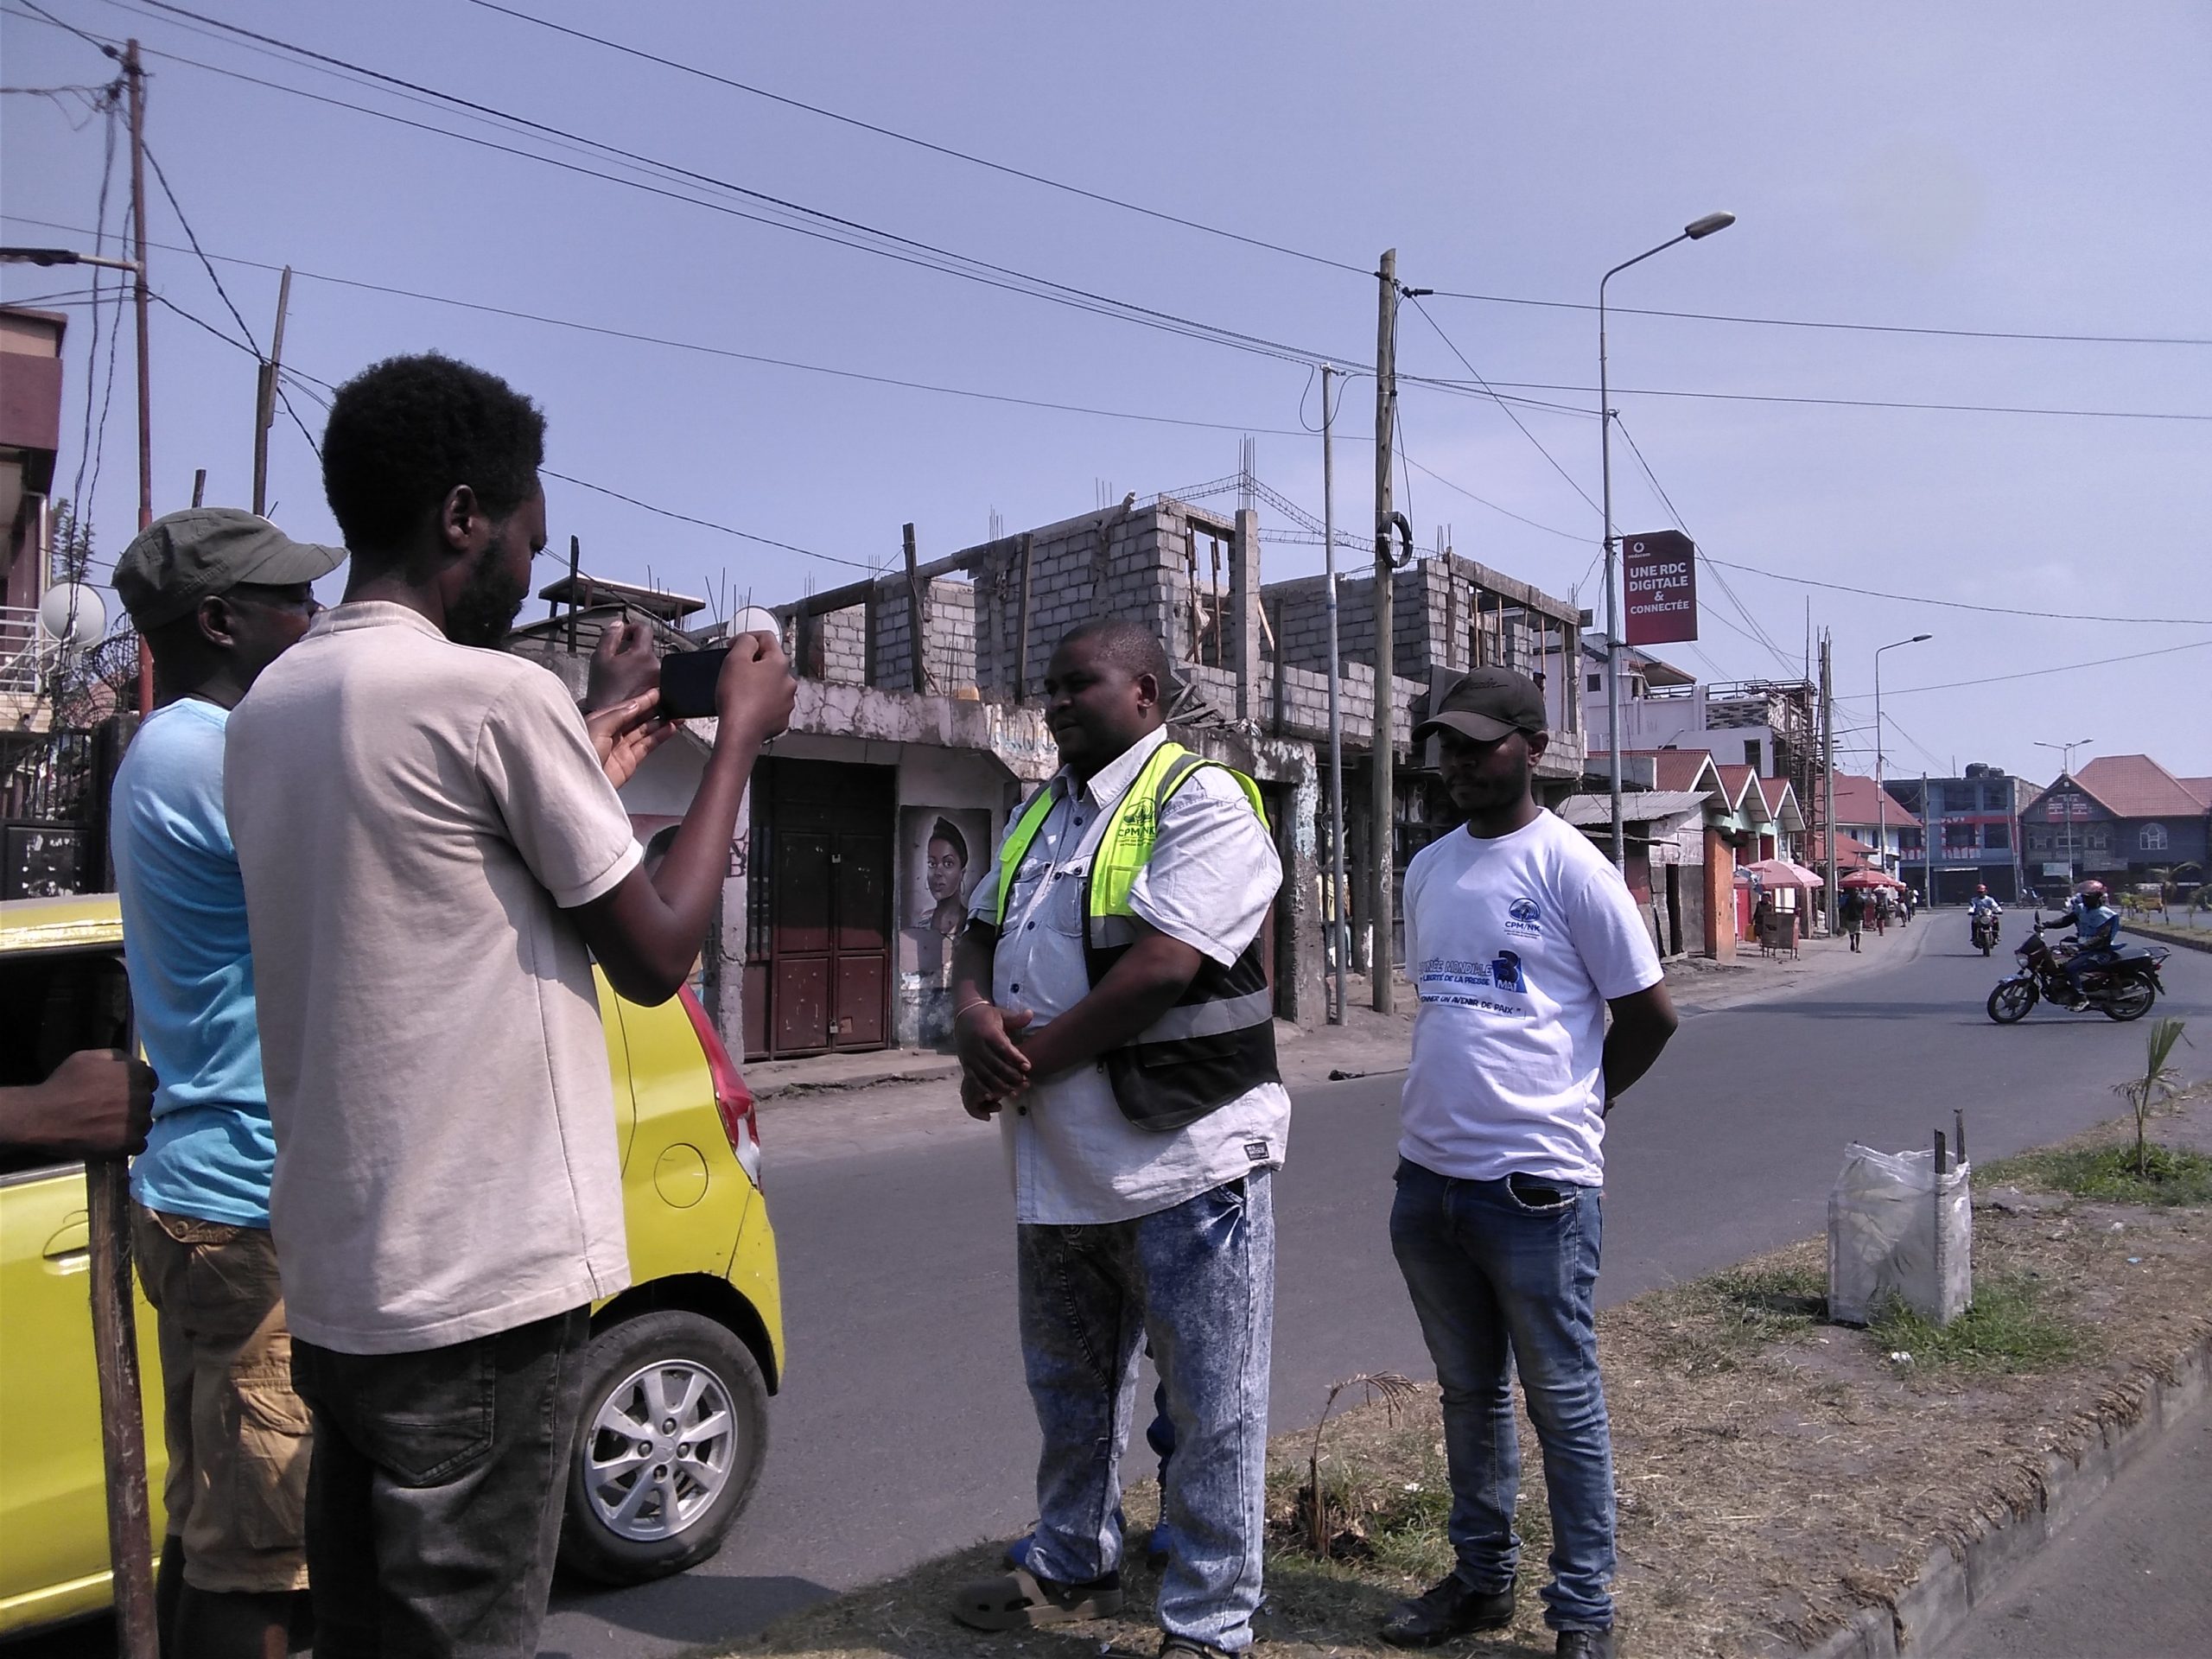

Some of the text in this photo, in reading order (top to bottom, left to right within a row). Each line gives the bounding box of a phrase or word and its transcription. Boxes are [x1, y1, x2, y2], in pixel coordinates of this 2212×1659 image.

[1630, 562, 1687, 578] UNE RDC
[1629, 575, 1688, 592] DIGITALE
[1654, 591, 1664, 601] &
[1630, 599, 1690, 614] CONNECTÉE
[1504, 921, 1541, 931] CPM/NK
[1445, 960, 1493, 976] MONDIALE
[1497, 950, 1519, 982] 3
[1465, 976, 1491, 985] PRESSE
[1497, 979, 1517, 992] MAI
[1451, 996, 1478, 1007] AVENIR
[1481, 1001, 1492, 1009] DE
[1494, 1003, 1514, 1014] PAIX
